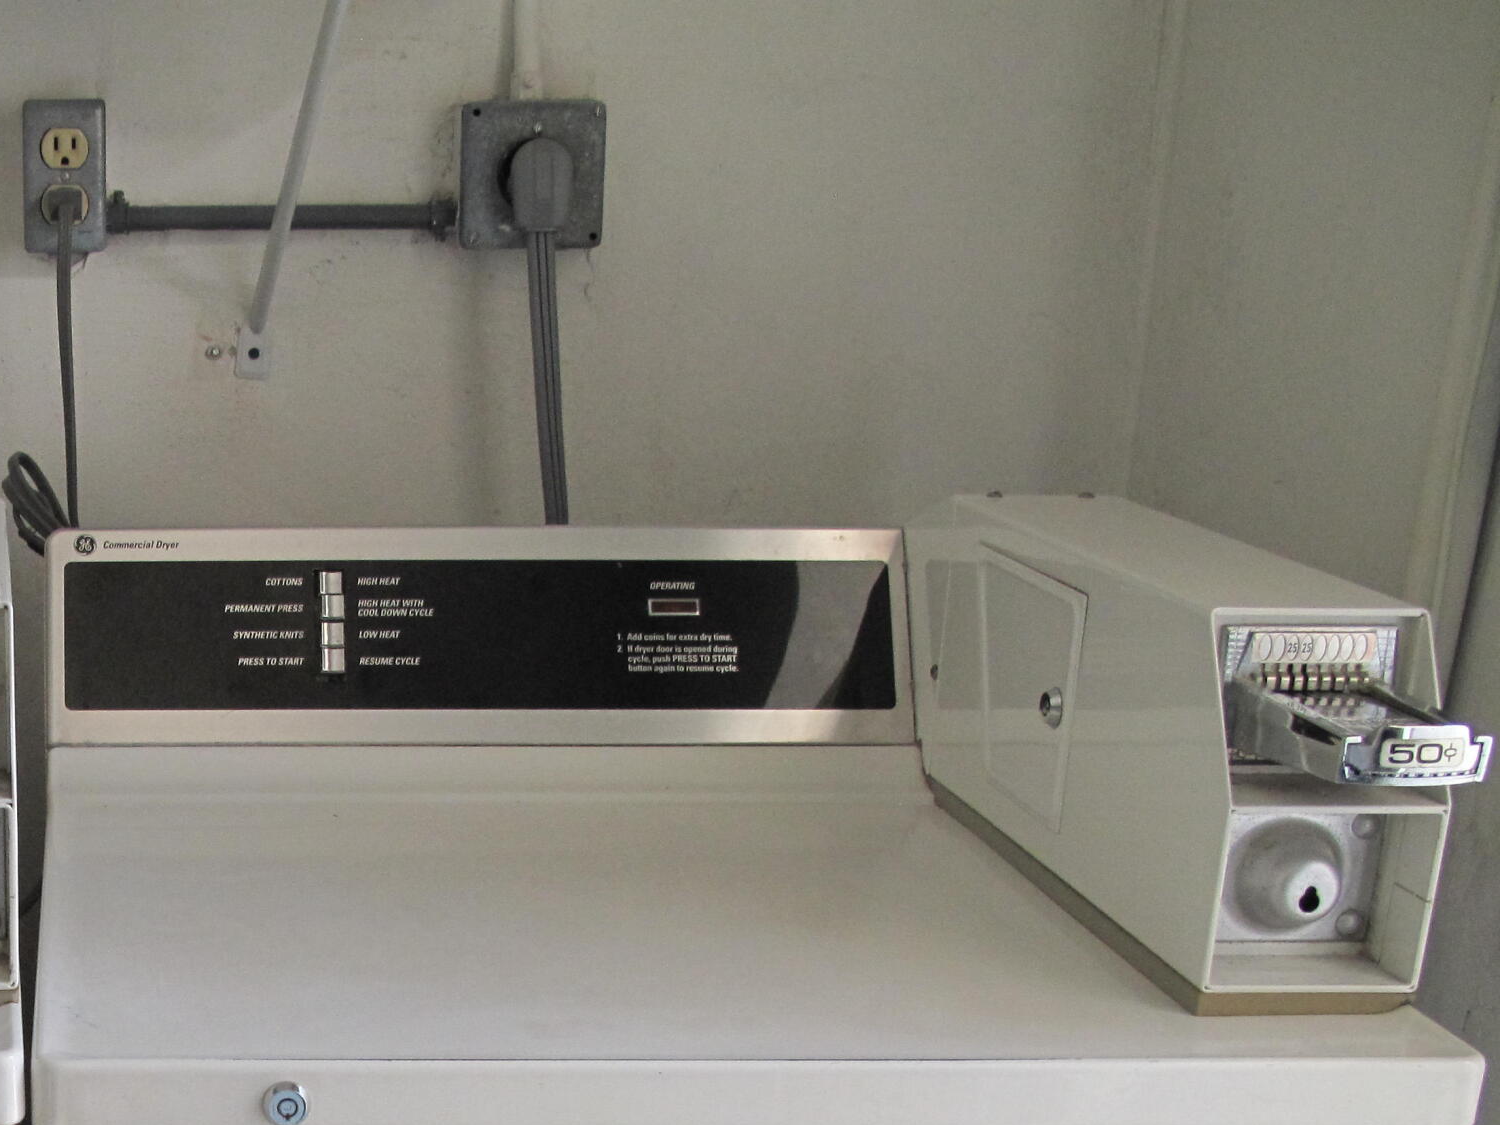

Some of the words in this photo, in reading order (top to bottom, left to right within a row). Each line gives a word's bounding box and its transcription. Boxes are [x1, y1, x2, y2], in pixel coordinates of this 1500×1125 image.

[103, 540, 154, 550] Commercial
[155, 540, 180, 550] Dryer
[265, 577, 303, 586] COTTONS
[357, 577, 378, 586] HIGH
[379, 577, 401, 586] HEAT
[649, 581, 696, 590] OPERATING
[358, 600, 378, 608] HIGH
[379, 599, 401, 608] HEAT
[402, 599, 424, 608] WITH
[225, 604, 275, 613] PERMANENT
[277, 604, 304, 613] PRESS
[357, 608, 379, 617] COOL
[380, 608, 407, 617] DOWN
[408, 608, 434, 617] CYCLE
[233, 631, 278, 640] SYNTHETIC
[279, 631, 304, 639] KNITS
[359, 630, 379, 639] LOW
[379, 630, 401, 639] HEAT
[627, 633, 642, 641] Add
[644, 633, 664, 641] coins
[666, 633, 677, 641] for
[678, 633, 698, 641] extra
[700, 633, 712, 643] dry
[634, 645, 654, 655] dryer
[656, 645, 673, 653] door
[674, 645, 682, 653] is
[683, 645, 712, 655] opened
[713, 645, 738, 655] during
[1288, 643, 1298, 654] 25
[1302, 643, 1312, 654] 25
[238, 657, 265, 666] PRESS
[266, 657, 277, 666] TO
[278, 657, 305, 666] START
[359, 656, 394, 666] RESUME
[395, 656, 421, 666] CYCLE
[652, 655, 671, 665] push
[672, 655, 698, 663] PRESS
[699, 655, 710, 663] TO
[712, 654, 737, 663] START
[628, 665, 652, 673] button
[653, 665, 676, 674] again
[1388, 743, 1457, 764] 50¢
